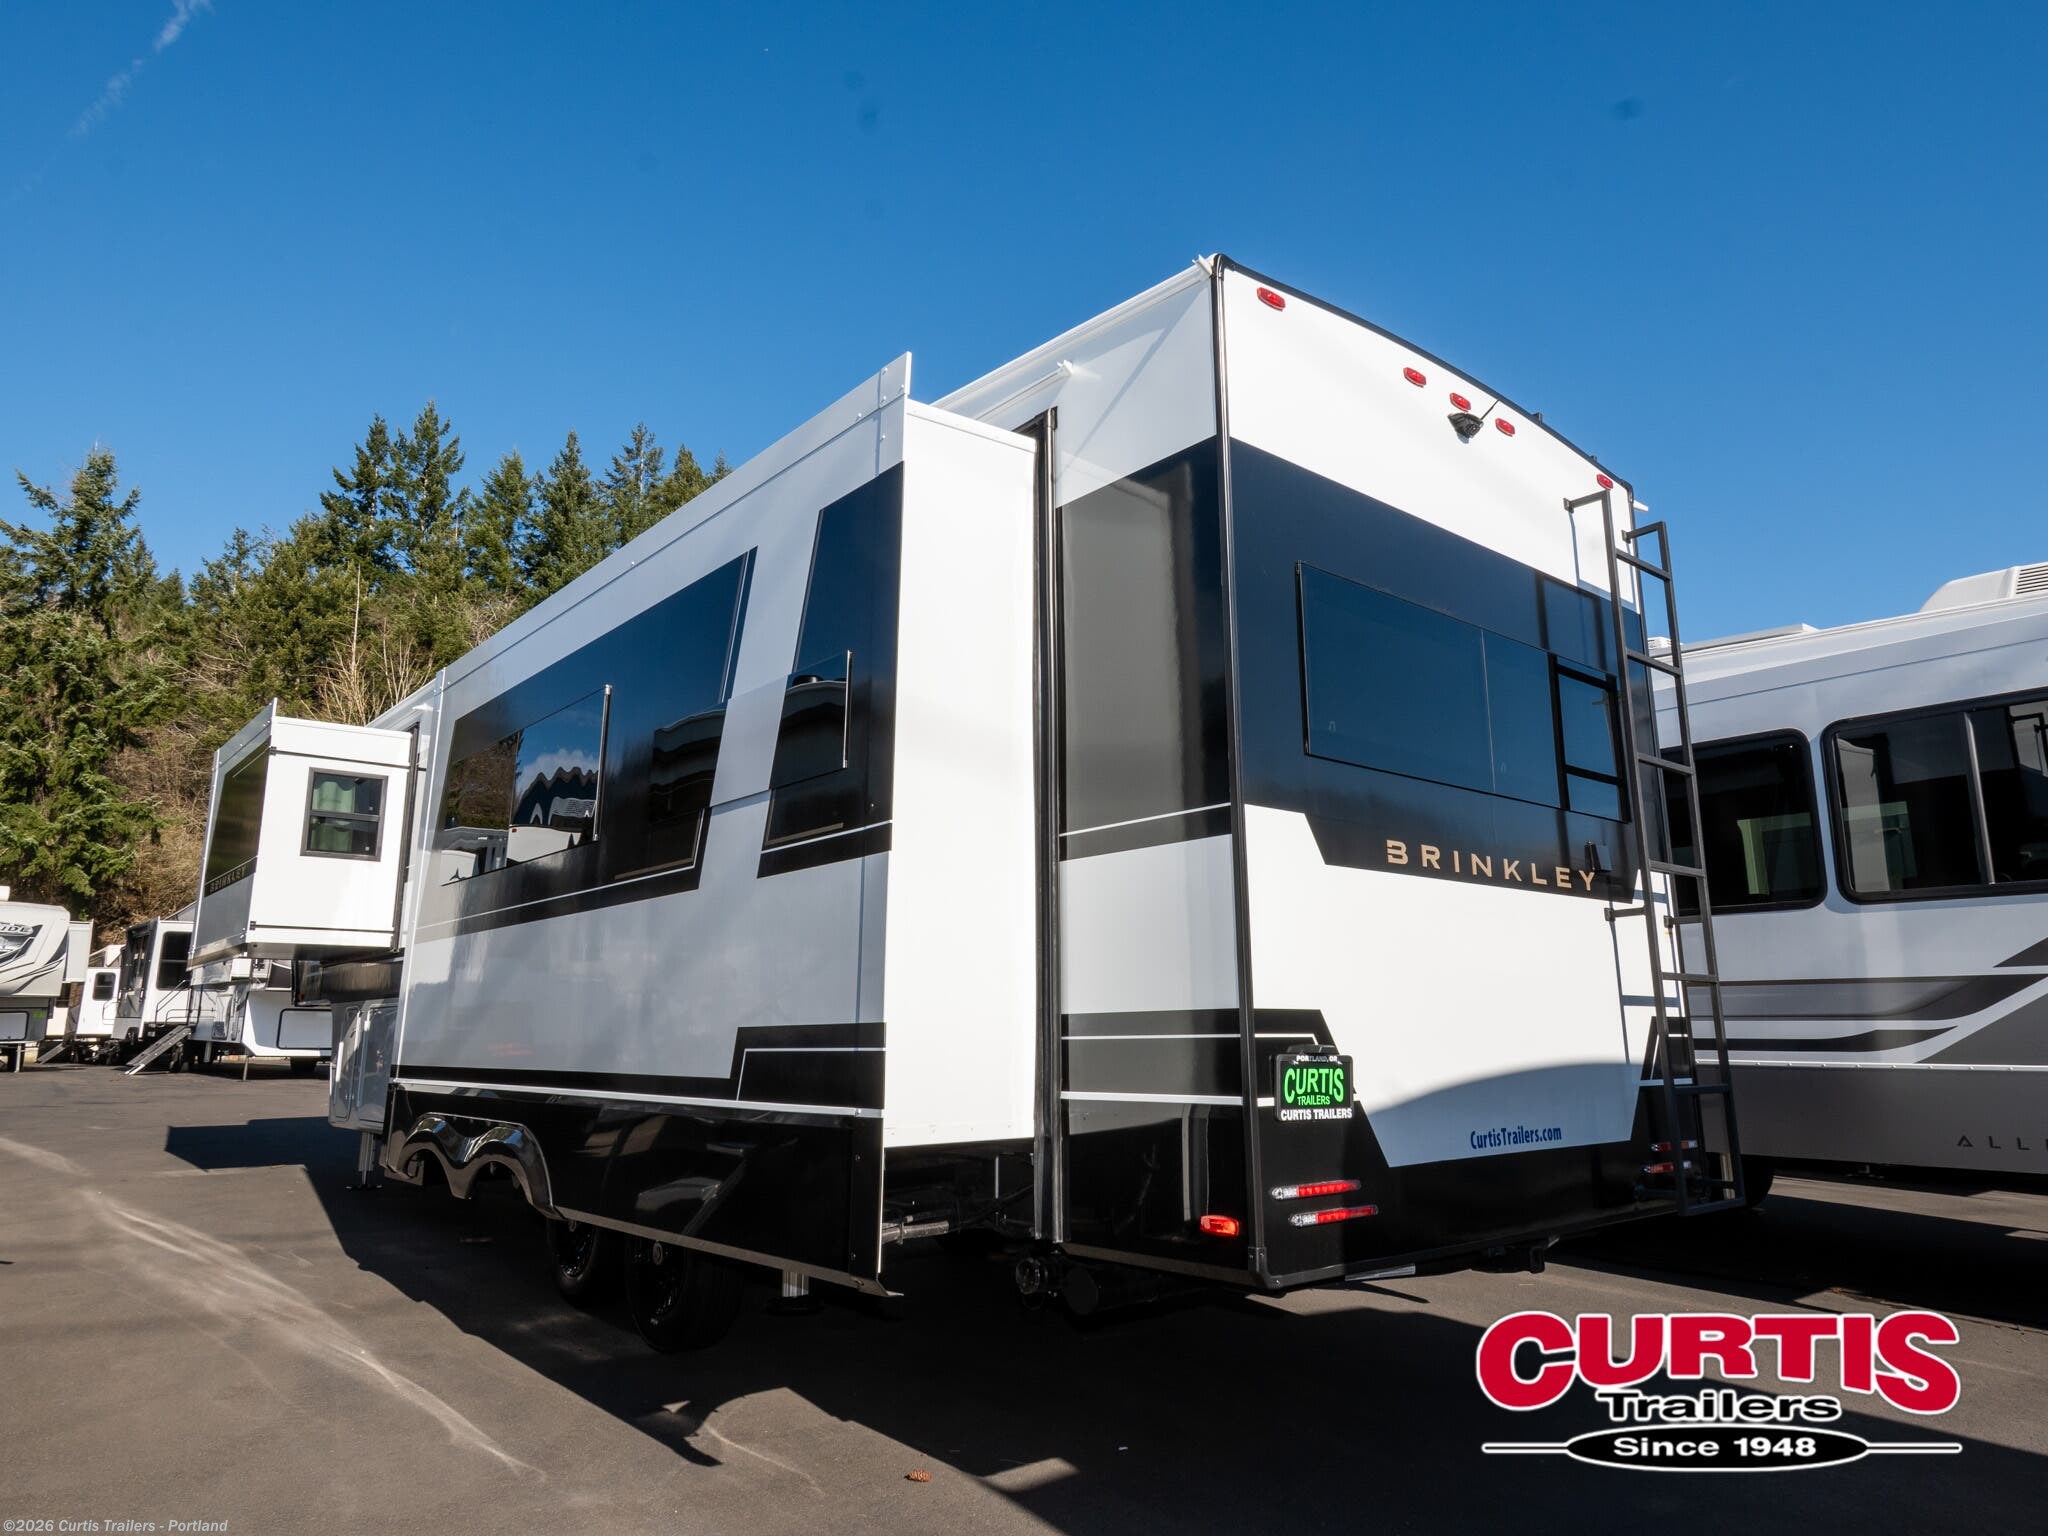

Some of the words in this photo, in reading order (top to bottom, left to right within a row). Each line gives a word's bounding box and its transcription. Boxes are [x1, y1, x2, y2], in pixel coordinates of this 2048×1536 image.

[1386, 839, 1595, 892] BRINKLEY
[1284, 1067, 1344, 1104] CURTIS
[1297, 1095, 1331, 1106] TRAILERS
[1280, 1109, 1312, 1121] CURTIS
[1313, 1108, 1353, 1119] TRAILERS
[1470, 1125, 1562, 1150] CurtisTrailers.com
